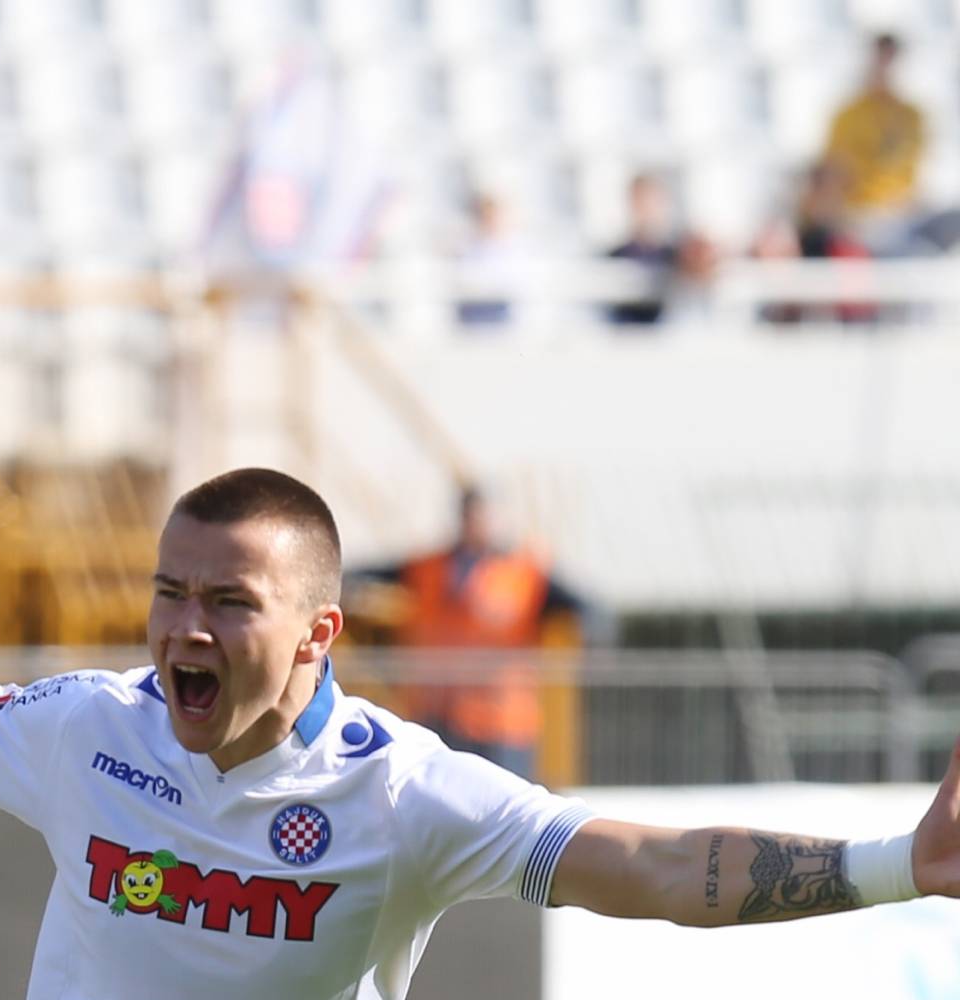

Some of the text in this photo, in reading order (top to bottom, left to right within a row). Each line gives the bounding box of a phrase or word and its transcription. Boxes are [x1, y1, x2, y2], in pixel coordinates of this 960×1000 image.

[91, 751, 182, 805] macron
[276, 806, 325, 827] HAJDUK
[279, 847, 317, 863] SPLIT
[85, 834, 341, 942] TOMMY
